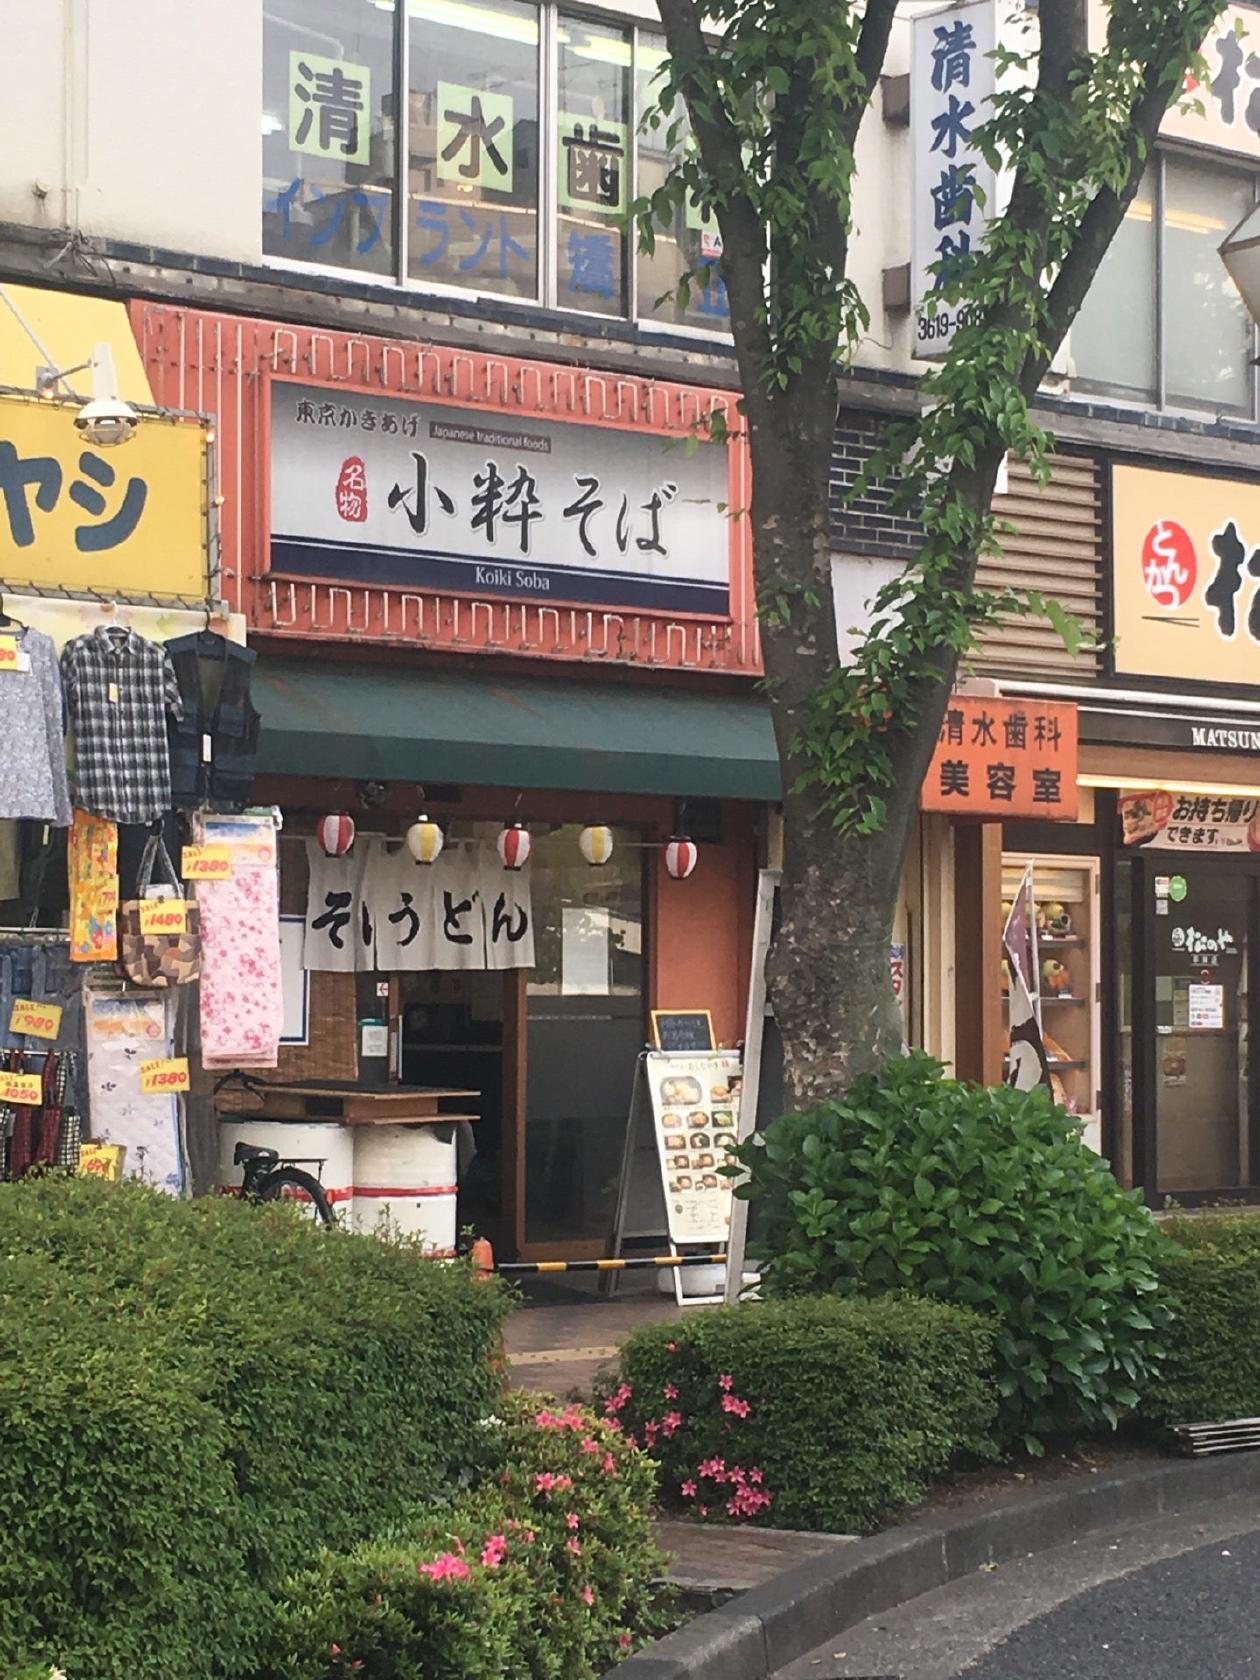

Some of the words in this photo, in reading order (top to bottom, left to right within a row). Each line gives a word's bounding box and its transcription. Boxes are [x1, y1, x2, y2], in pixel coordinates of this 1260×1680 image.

[296, 400, 418, 438] 東京かきあげ
[434, 424, 475, 441] Japanese
[477, 430, 522, 447] traditional
[523, 436, 549, 451] foods
[342, 464, 363, 518] 名物
[476, 565, 512, 586] Koiki
[515, 570, 550, 590] Soba
[940, 709, 1062, 752] 清水歯科
[940, 759, 1062, 803] 美容室
